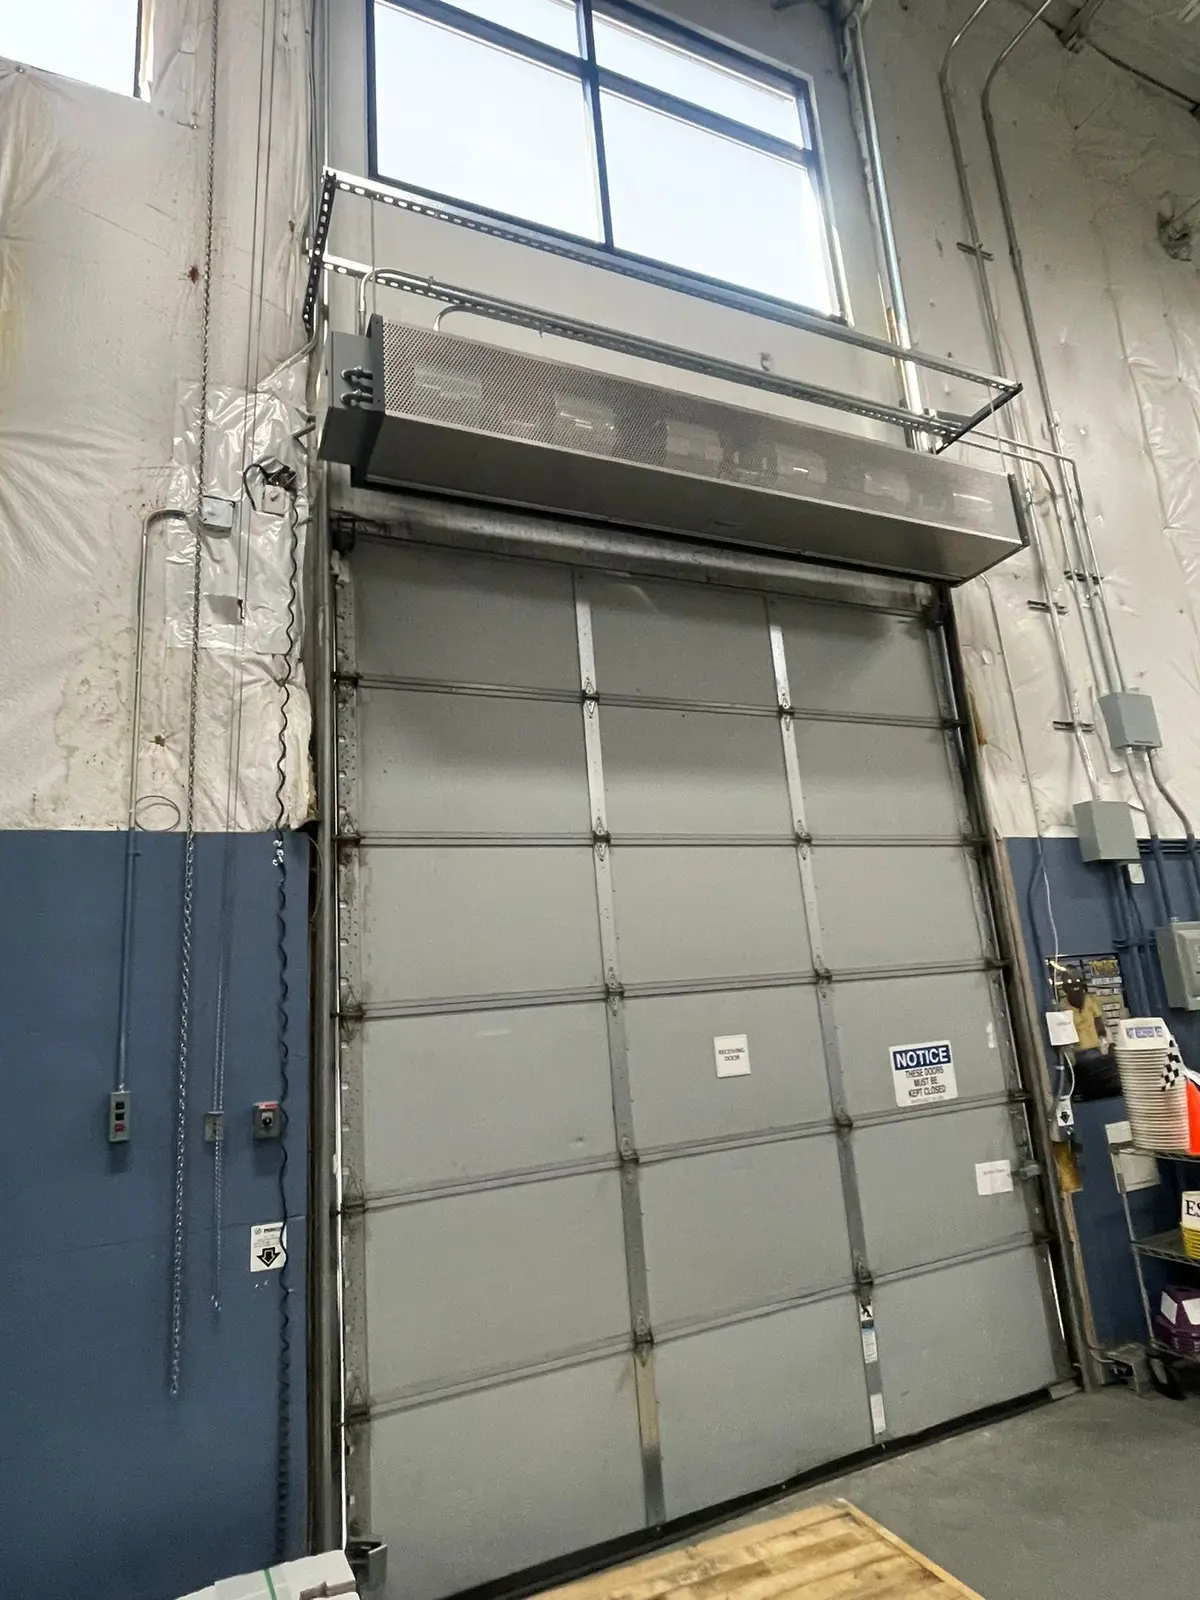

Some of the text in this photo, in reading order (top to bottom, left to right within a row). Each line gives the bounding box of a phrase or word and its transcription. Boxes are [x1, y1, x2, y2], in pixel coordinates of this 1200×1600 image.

[895, 1047, 949, 1068] NOTICE
[905, 1066, 944, 1078] THESE DOORS
[914, 1076, 938, 1086] MUST BE
[908, 1085, 946, 1097] KEPT CLOSED
